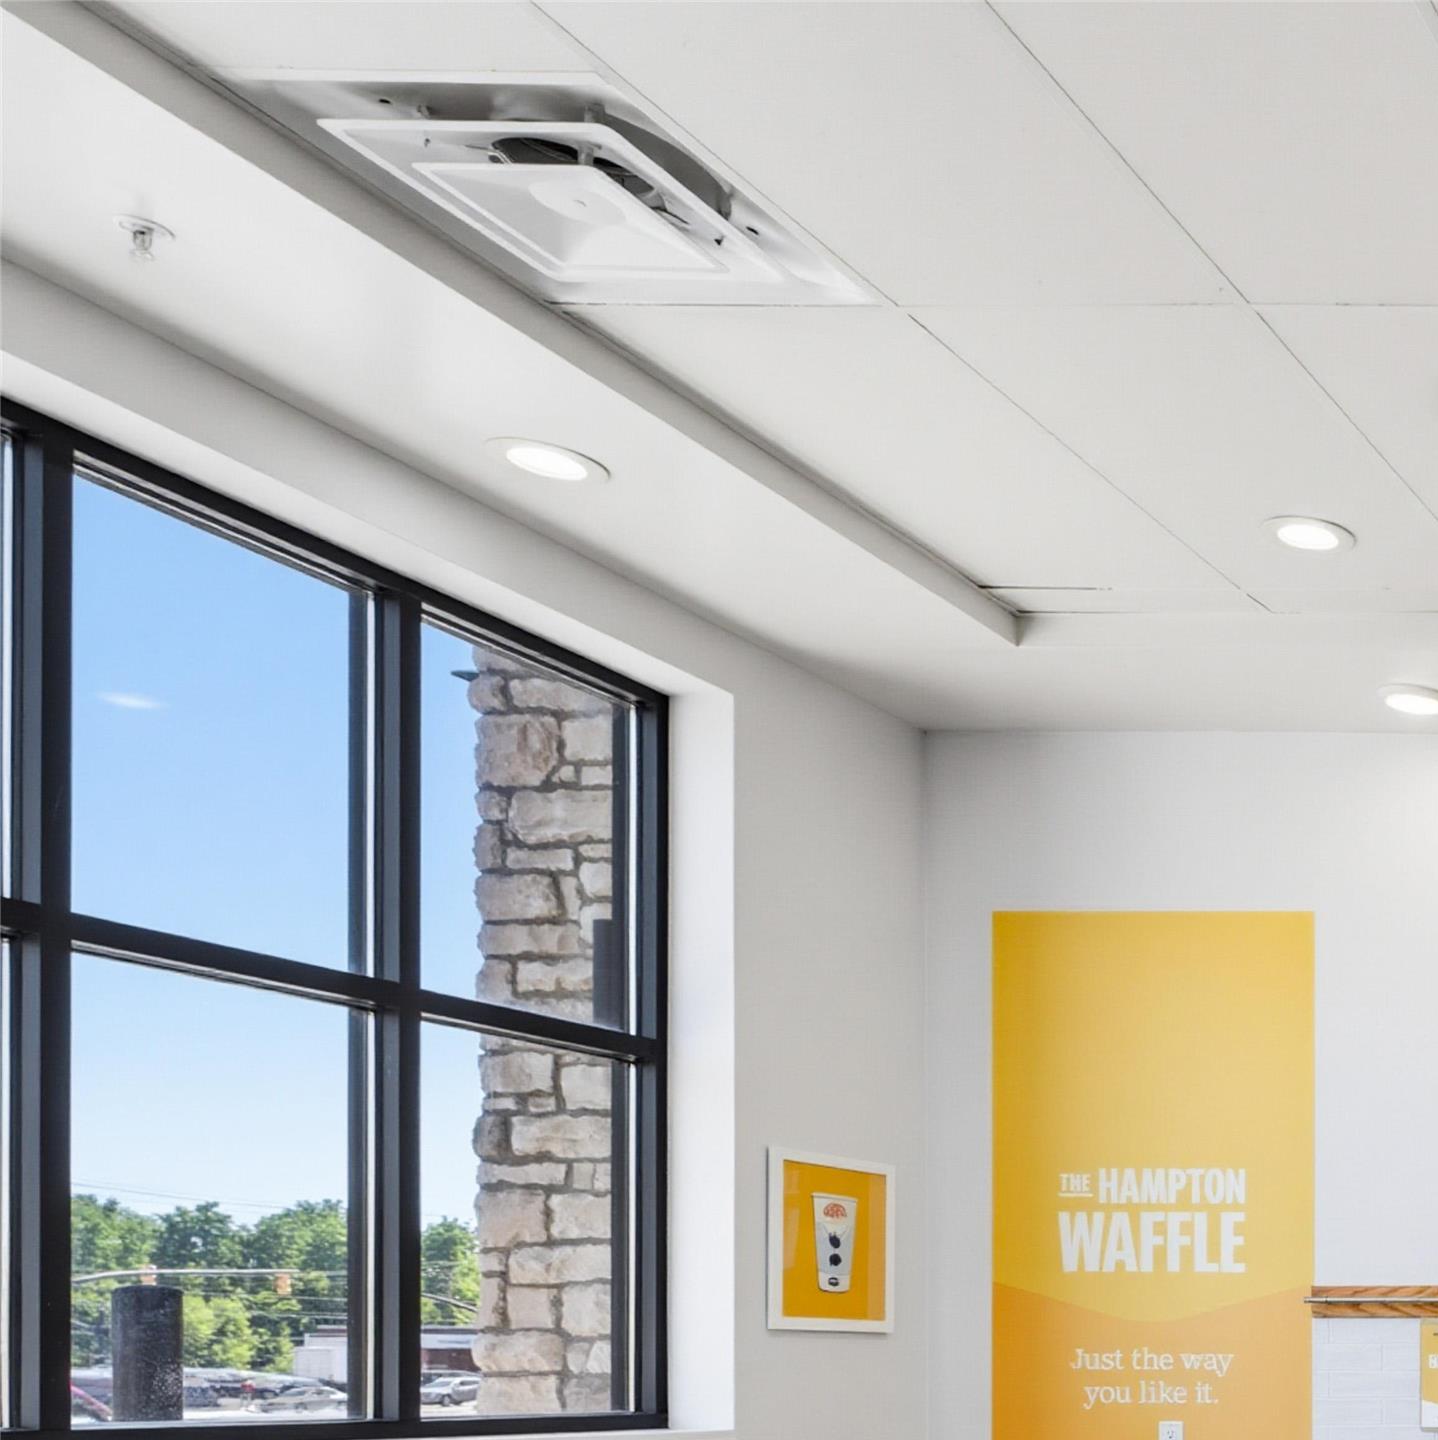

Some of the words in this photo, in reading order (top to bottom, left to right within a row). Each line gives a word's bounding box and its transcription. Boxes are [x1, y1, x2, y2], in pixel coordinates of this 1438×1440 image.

[1059, 1172, 1092, 1194] THE
[1098, 1167, 1246, 1204] HAMPTON
[1057, 1211, 1247, 1273] WAFFLE
[1069, 1348, 1124, 1371] Just
[1131, 1347, 1174, 1370] the
[1180, 1352, 1235, 1378] way
[1083, 1386, 1132, 1410] you
[1138, 1380, 1188, 1404] like
[1195, 1382, 1219, 1404] it.
